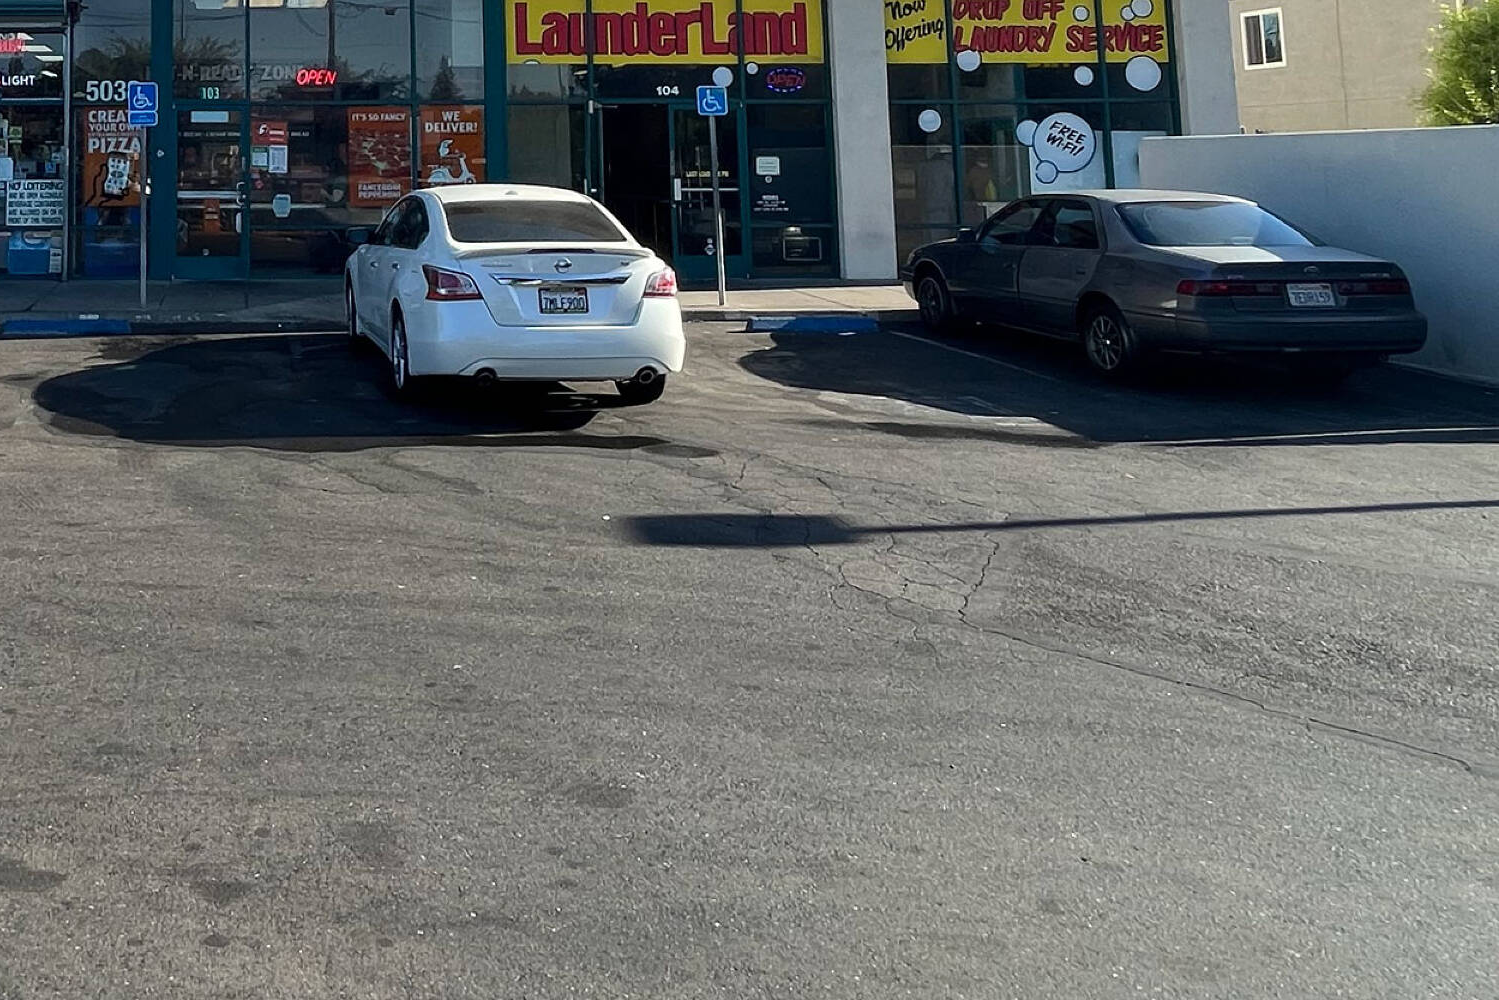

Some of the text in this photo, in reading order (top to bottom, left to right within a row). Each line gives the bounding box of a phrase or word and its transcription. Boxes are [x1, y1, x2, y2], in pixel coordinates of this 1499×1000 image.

[514, 1, 808, 56] LaunderLand
[884, 17, 945, 51] Offering
[954, 22, 1165, 53] LAUNDRY SERVICE
[2, 75, 36, 86] LIGHT
[297, 68, 337, 86] OPEN
[86, 80, 127, 101] 503
[201, 87, 220, 99] 103
[656, 85, 680, 96] 104
[441, 110, 461, 121] WE
[89, 123, 117, 132] YOUR
[424, 121, 478, 133] DELIVER!
[1049, 120, 1087, 144] FREE
[88, 137, 141, 154] PIZZA
[9, 182, 21, 191] NO
